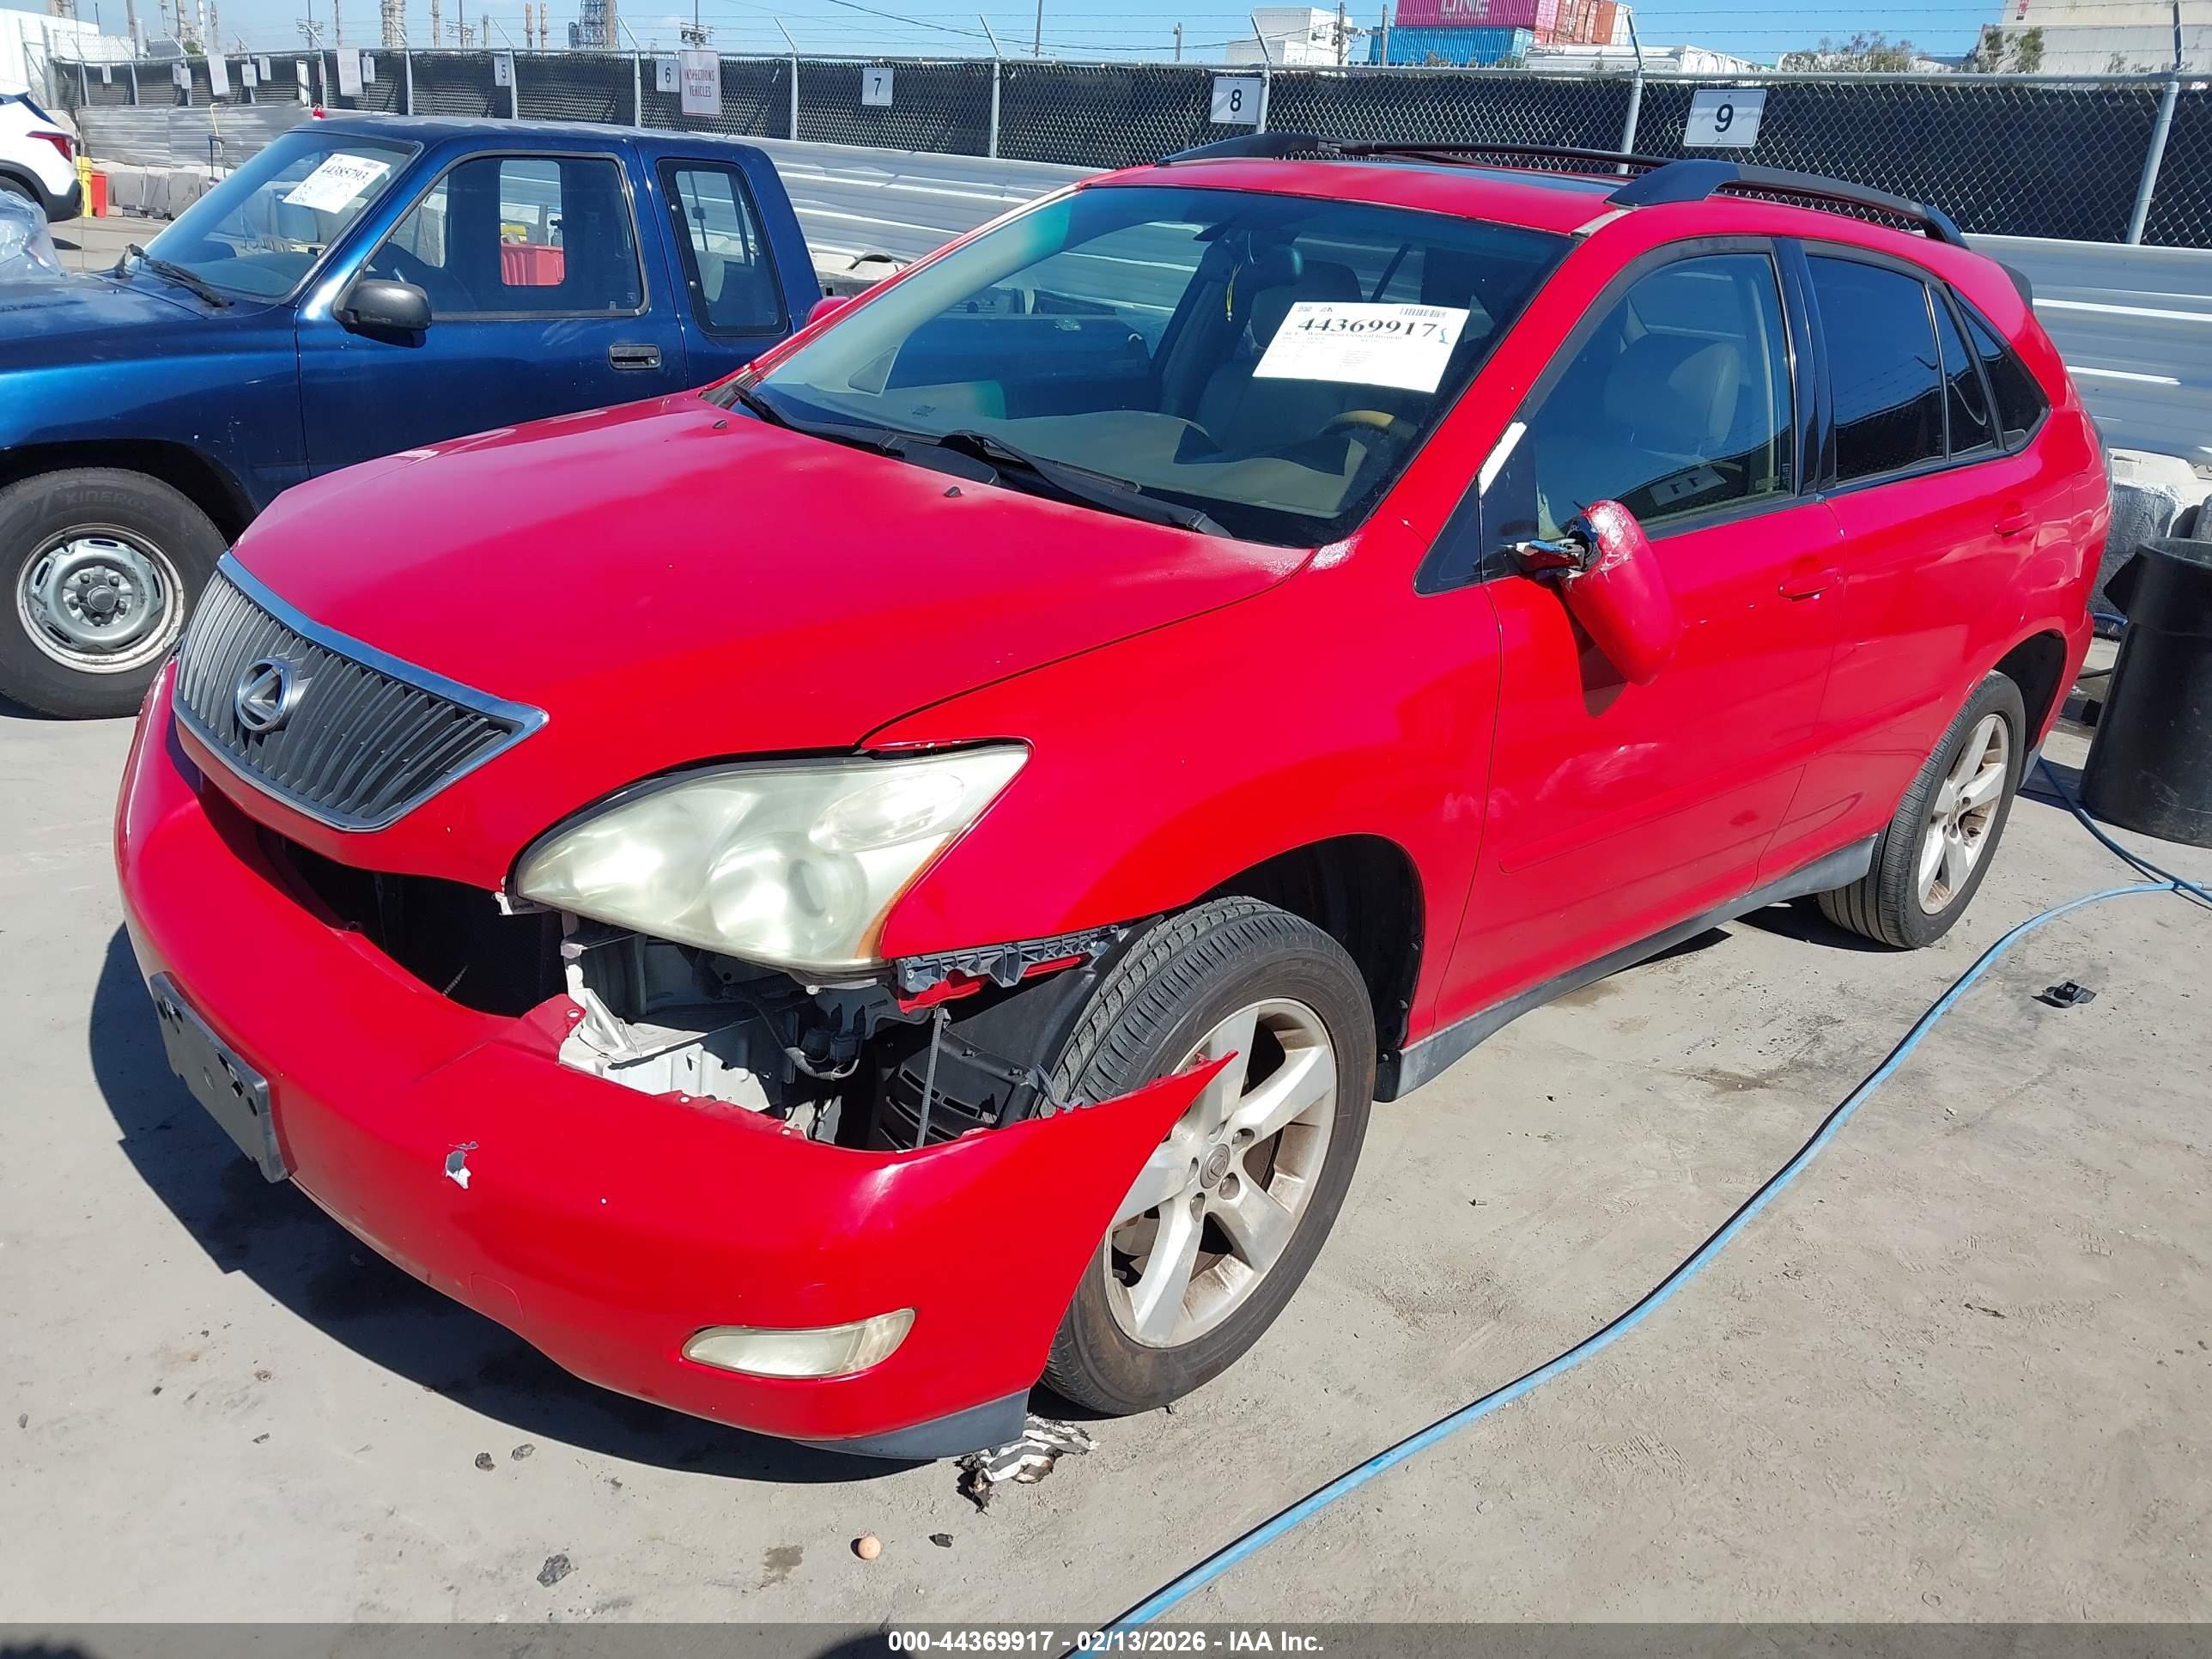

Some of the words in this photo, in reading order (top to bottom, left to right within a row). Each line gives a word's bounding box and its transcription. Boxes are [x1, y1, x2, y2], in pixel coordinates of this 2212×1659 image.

[501, 64, 507, 79] 5
[665, 67, 672, 83] 6
[684, 69, 715, 82] INSPECTIONS
[689, 85, 712, 97] VEHICLES
[874, 78, 882, 95] 7
[1231, 88, 1243, 112] 8
[1714, 104, 1734, 132] 9
[1297, 318, 1438, 337] 44369917
